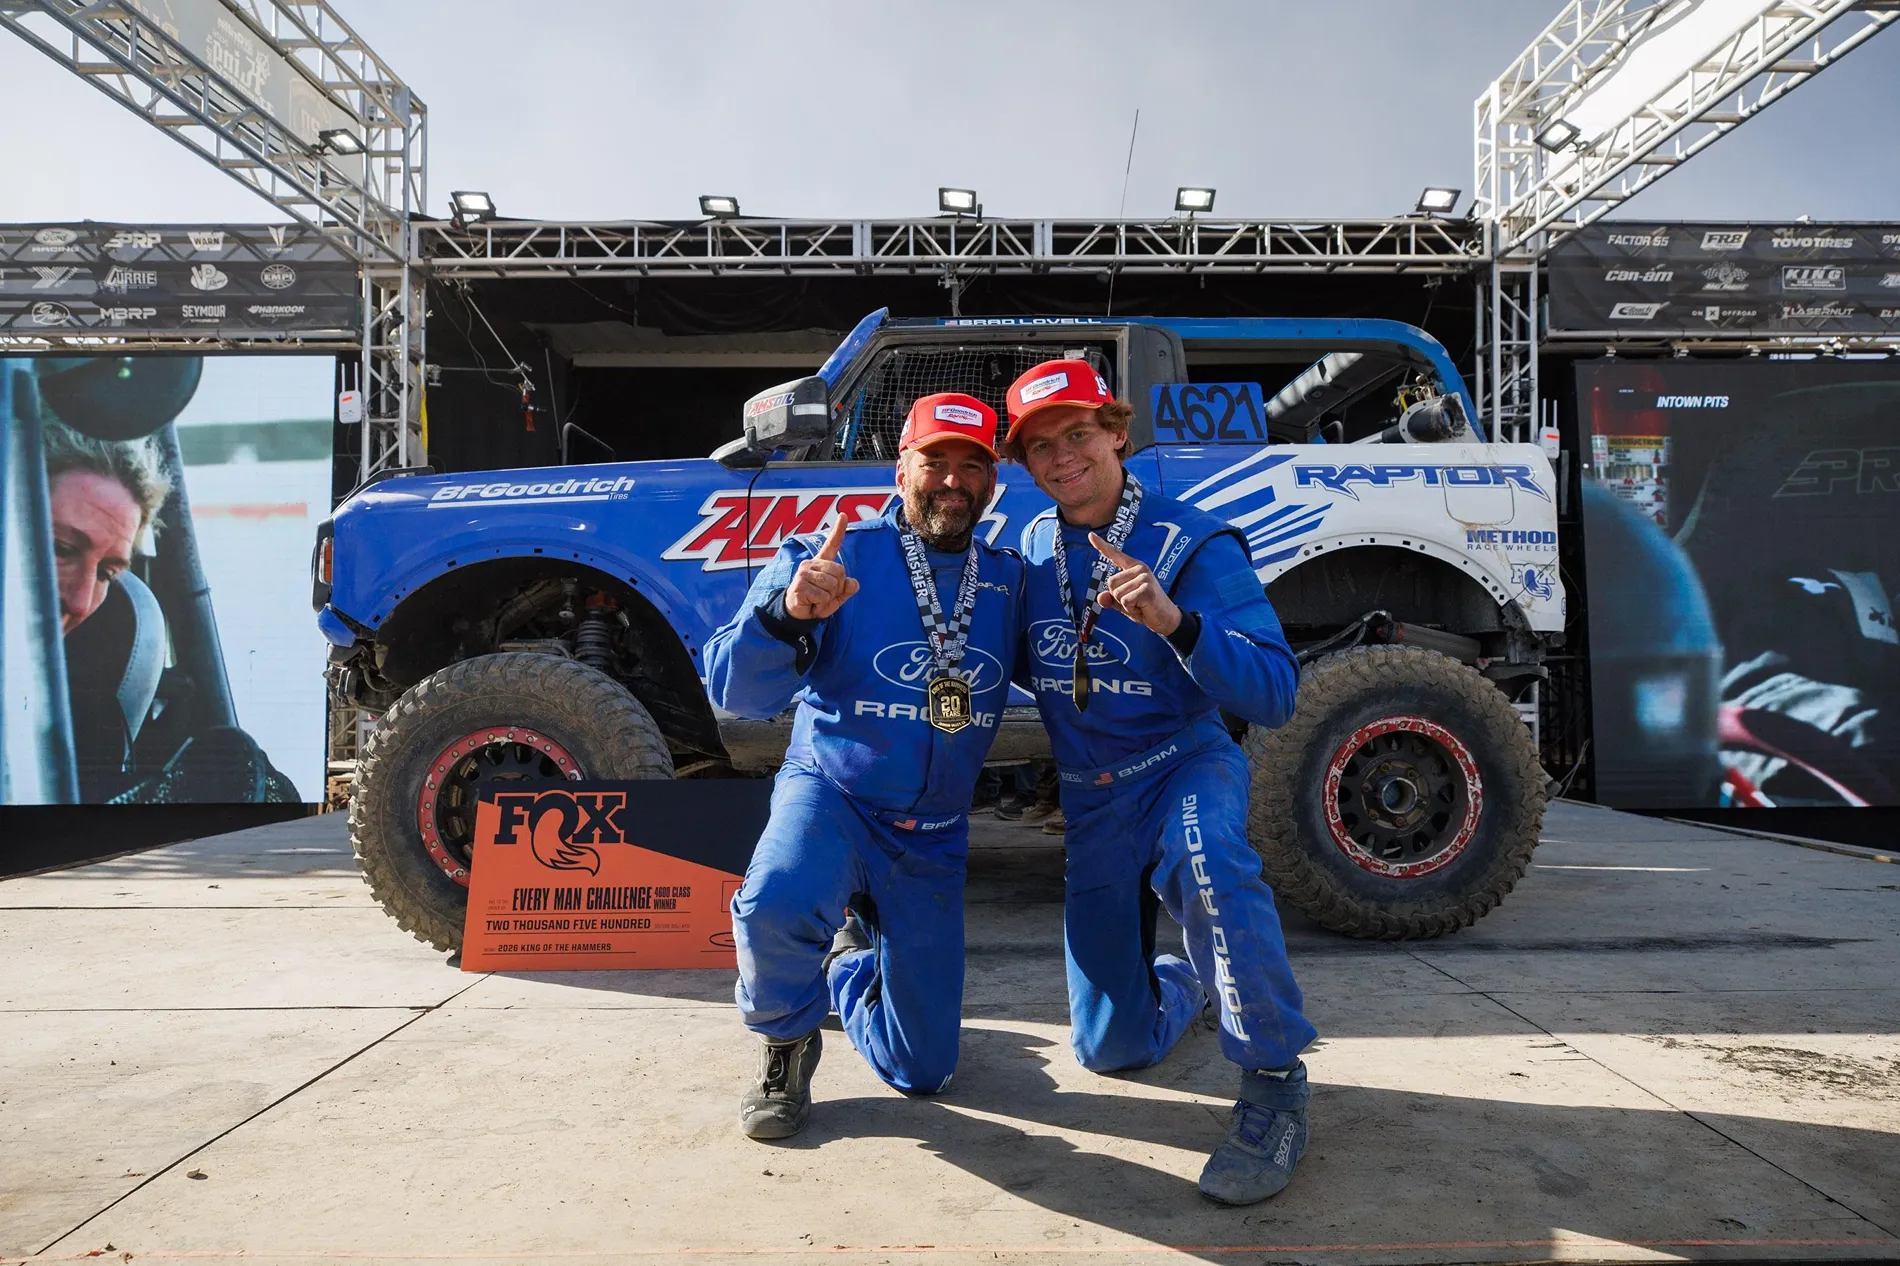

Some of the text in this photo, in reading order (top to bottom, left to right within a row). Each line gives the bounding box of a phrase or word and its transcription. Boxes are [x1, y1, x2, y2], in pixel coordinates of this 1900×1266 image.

[193, 237, 220, 245] WARN
[1607, 235, 1651, 246] FACTOR
[1771, 237, 1854, 248] TOYO TIRES
[106, 267, 156, 285] CURRIE
[263, 272, 293, 280] EMPI
[1785, 269, 1842, 280] KING
[100, 307, 157, 320] MBRP
[182, 305, 226, 317] SEYMOUR
[748, 392, 795, 417] AMSOIL
[1656, 396, 1730, 408] INTOWN PITS
[1155, 383, 1264, 441] 4621
[430, 476, 637, 501] BFGoodrich
[1292, 463, 1551, 502] RAPTOR
[608, 491, 629, 500] Tires
[1467, 530, 1556, 544] METHOD
[1467, 543, 1557, 552] RACE WHEELS
[901, 533, 928, 598] FINISHER
[1157, 535, 1191, 580] sparco
[963, 551, 979, 609] FINISHER
[1511, 563, 1556, 601] FOX
[926, 576, 940, 611] HAMMERS
[1030, 676, 1153, 697] RACNG
[940, 695, 961, 712] 20
[854, 700, 996, 728] RACNG
[1117, 745, 1178, 778] BYAM
[494, 790, 627, 876] FOX
[1183, 793, 1220, 916] RACING
[512, 887, 652, 911] EVERY MAN CHALLENGE
[654, 886, 691, 897] 4600 CLASS
[653, 899, 677, 910] WINNER
[486, 918, 651, 930] TWO THOUSAND FIVE HUNDRED
[498, 944, 518, 952] 2026
[555, 943, 569, 951] THE
[571, 943, 611, 951] HAMMERS
[1212, 925, 1250, 1042] FORD
[1273, 1122, 1297, 1170] sparco
